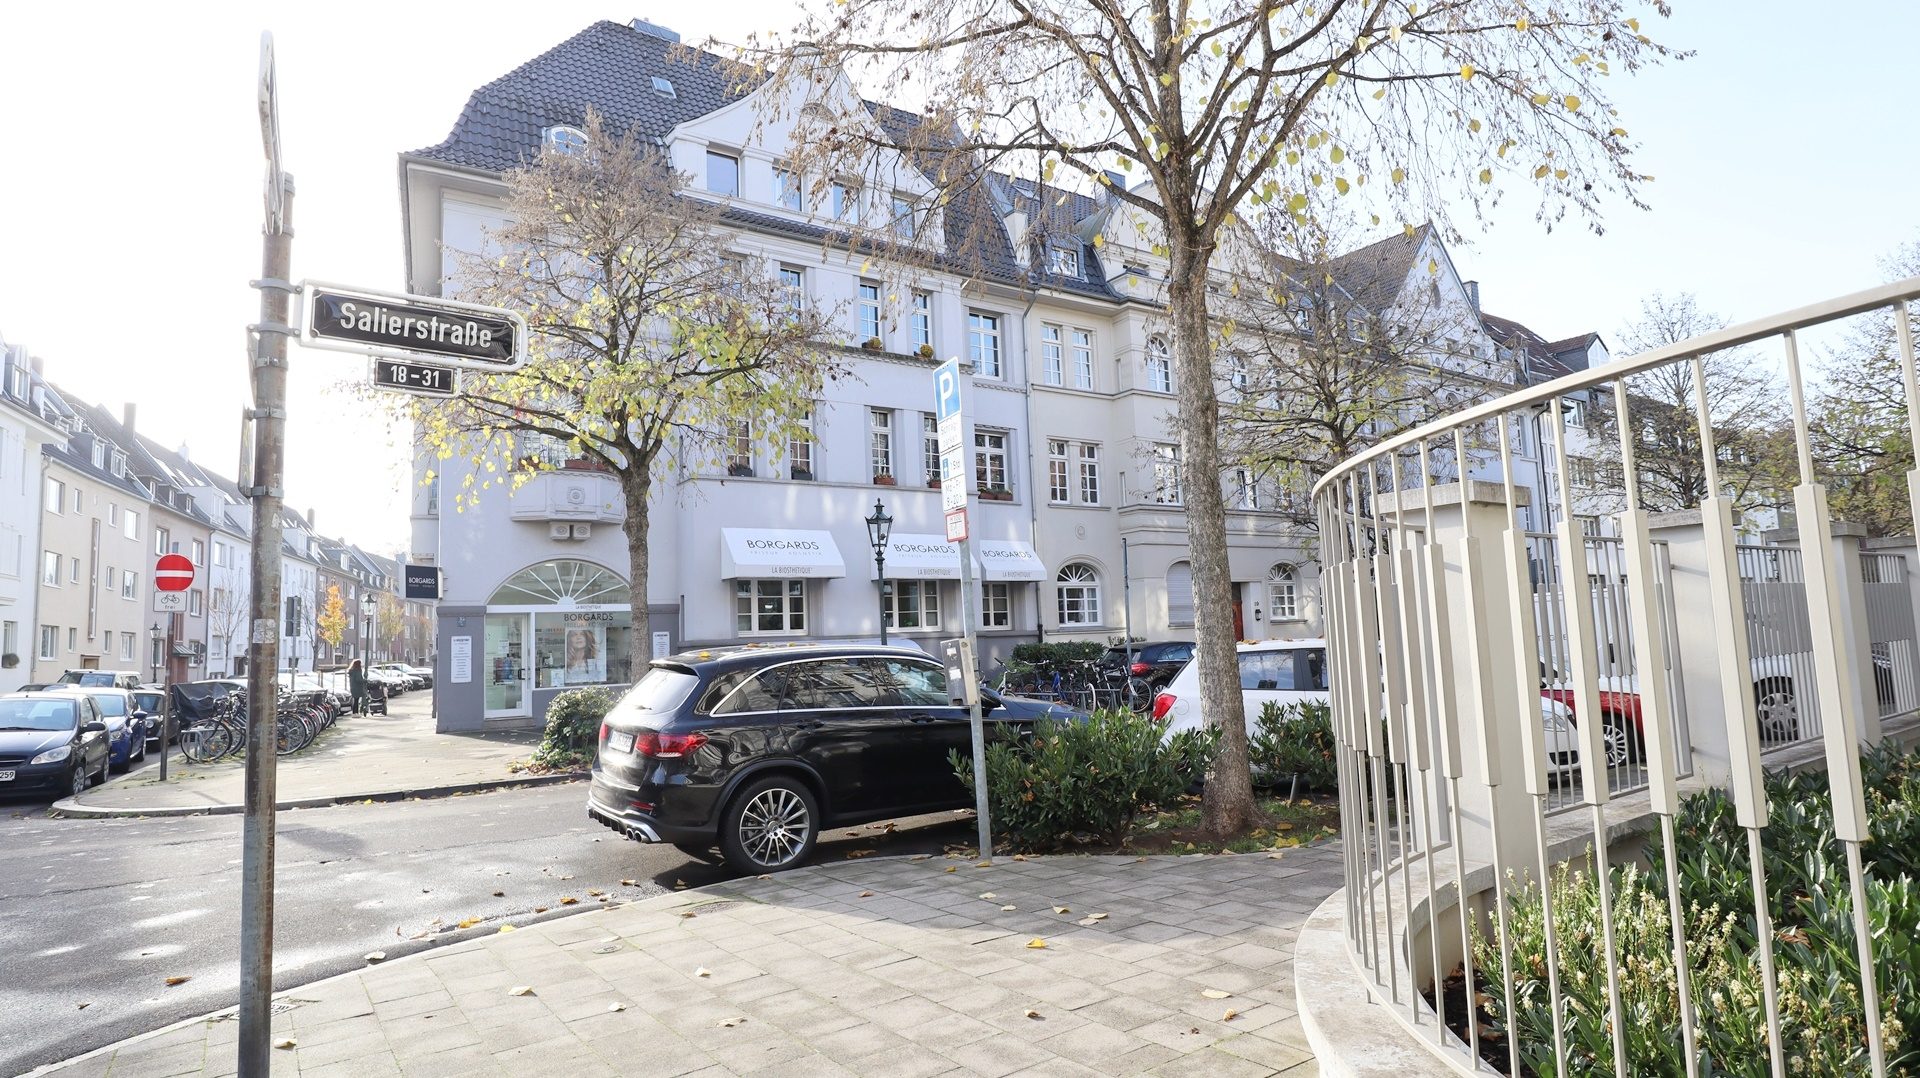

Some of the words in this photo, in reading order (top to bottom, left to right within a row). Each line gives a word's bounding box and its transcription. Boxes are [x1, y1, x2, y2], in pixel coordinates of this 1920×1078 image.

[340, 302, 492, 348] Salierstraße
[939, 371, 954, 418] P
[746, 539, 820, 550] BORGARDS
[893, 543, 956, 554] BORGARDS
[982, 550, 1032, 558] BORGARDS
[771, 566, 778, 574] LA
[408, 577, 436, 585] BORGARDS
[564, 613, 614, 621] BORGARDS
[0, 771, 14, 779] 259
